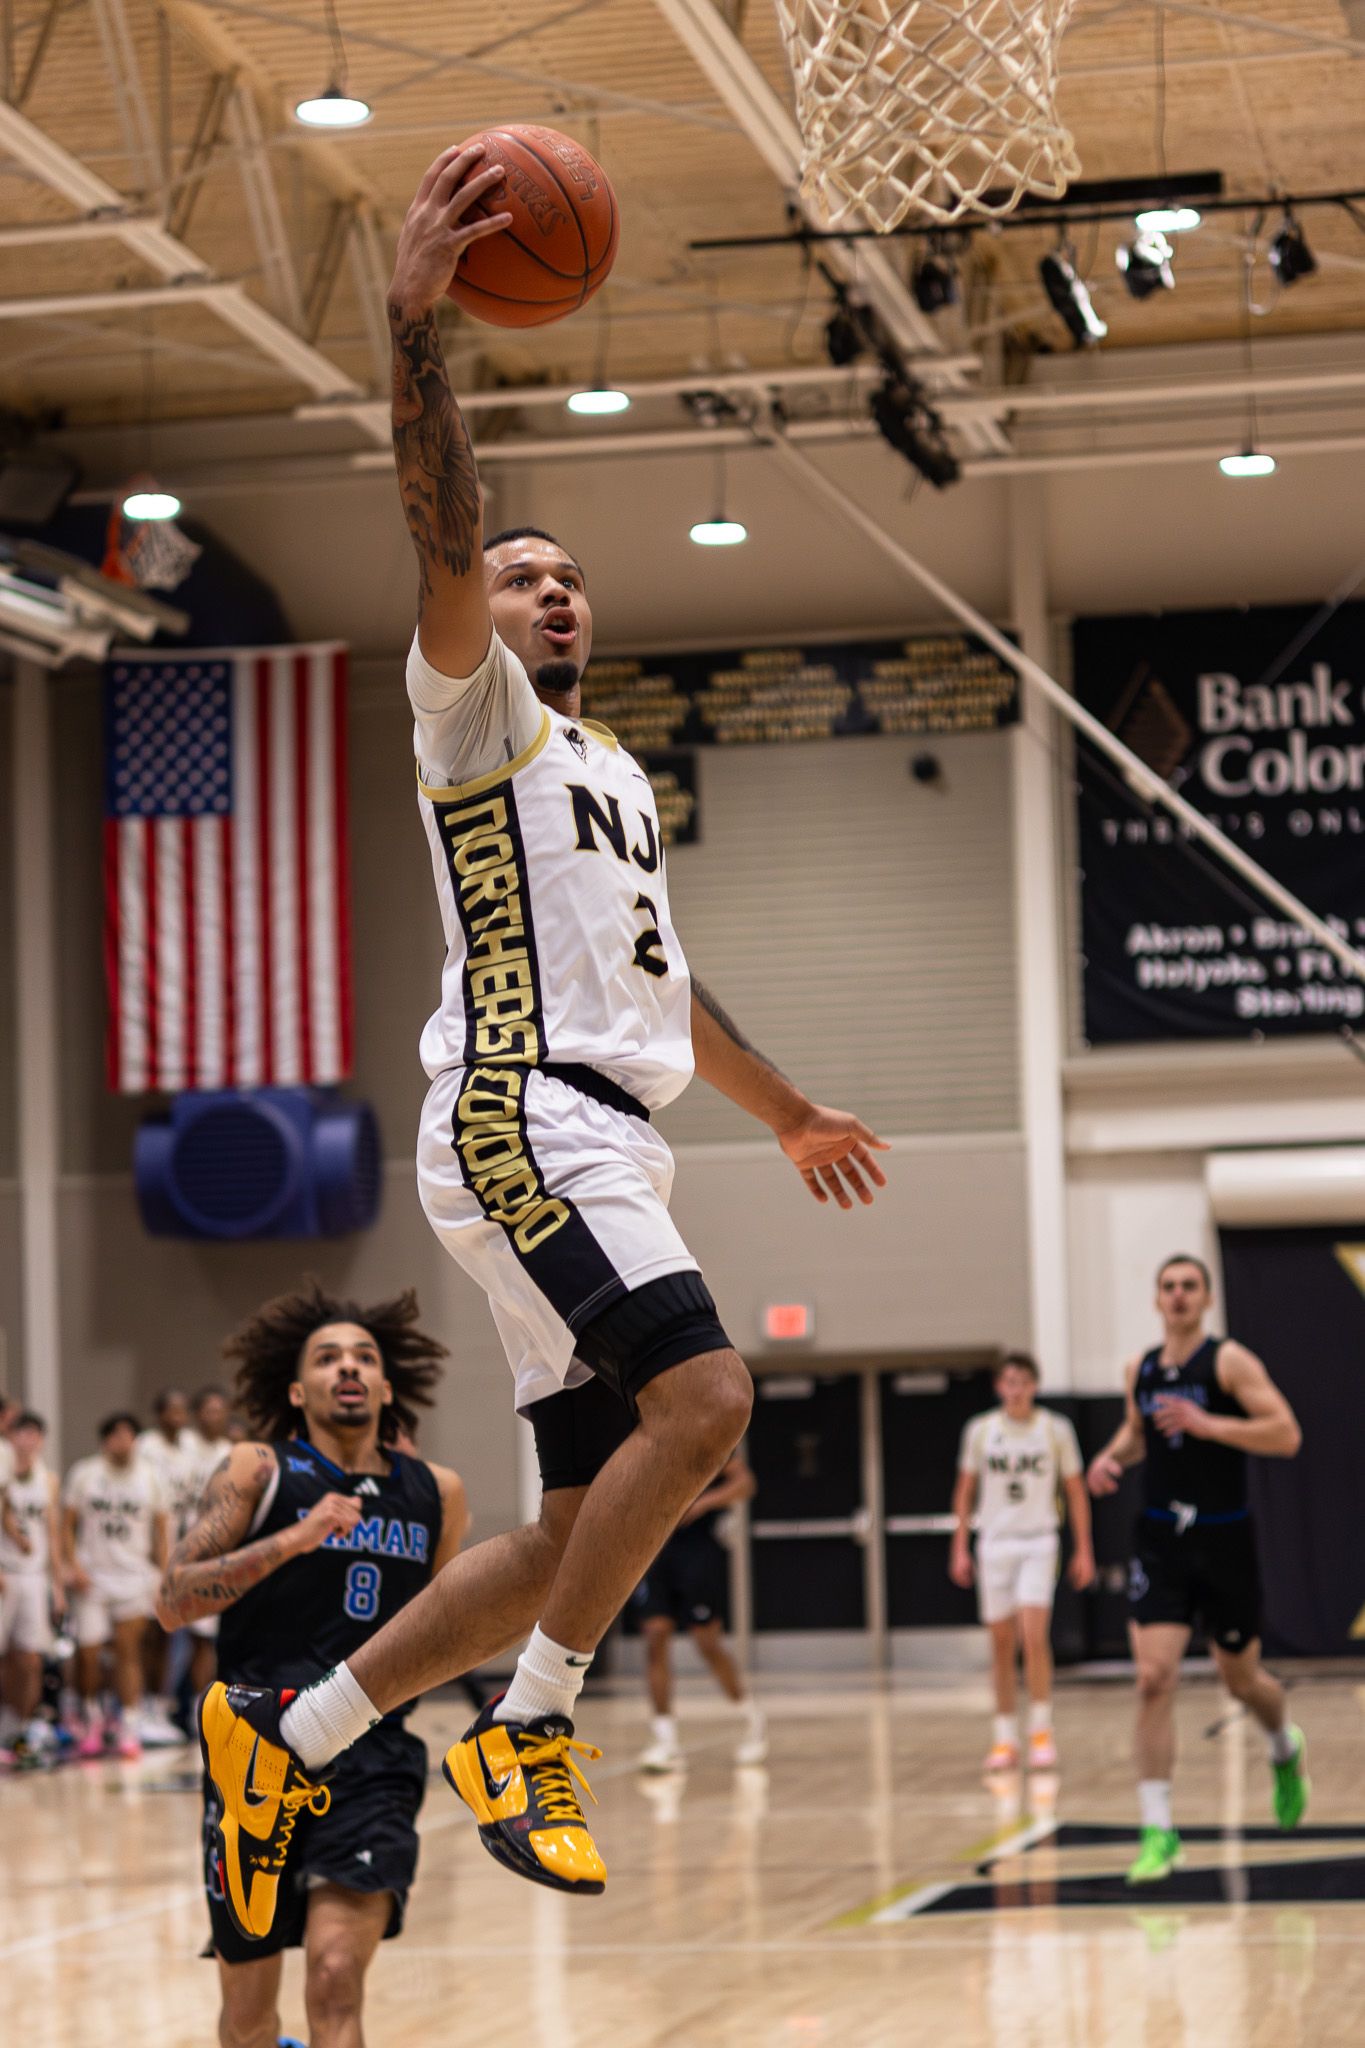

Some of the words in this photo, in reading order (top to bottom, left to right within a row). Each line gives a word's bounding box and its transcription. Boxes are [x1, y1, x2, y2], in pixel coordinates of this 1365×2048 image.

[1197, 661, 1355, 733] Bank
[564, 783, 664, 875] NJ
[633, 891, 669, 978] 2
[1127, 923, 1224, 954] Akron
[1254, 913, 1349, 949] Bruh
[297, 1508, 428, 1564] MAR
[343, 1561, 382, 1622] 8
